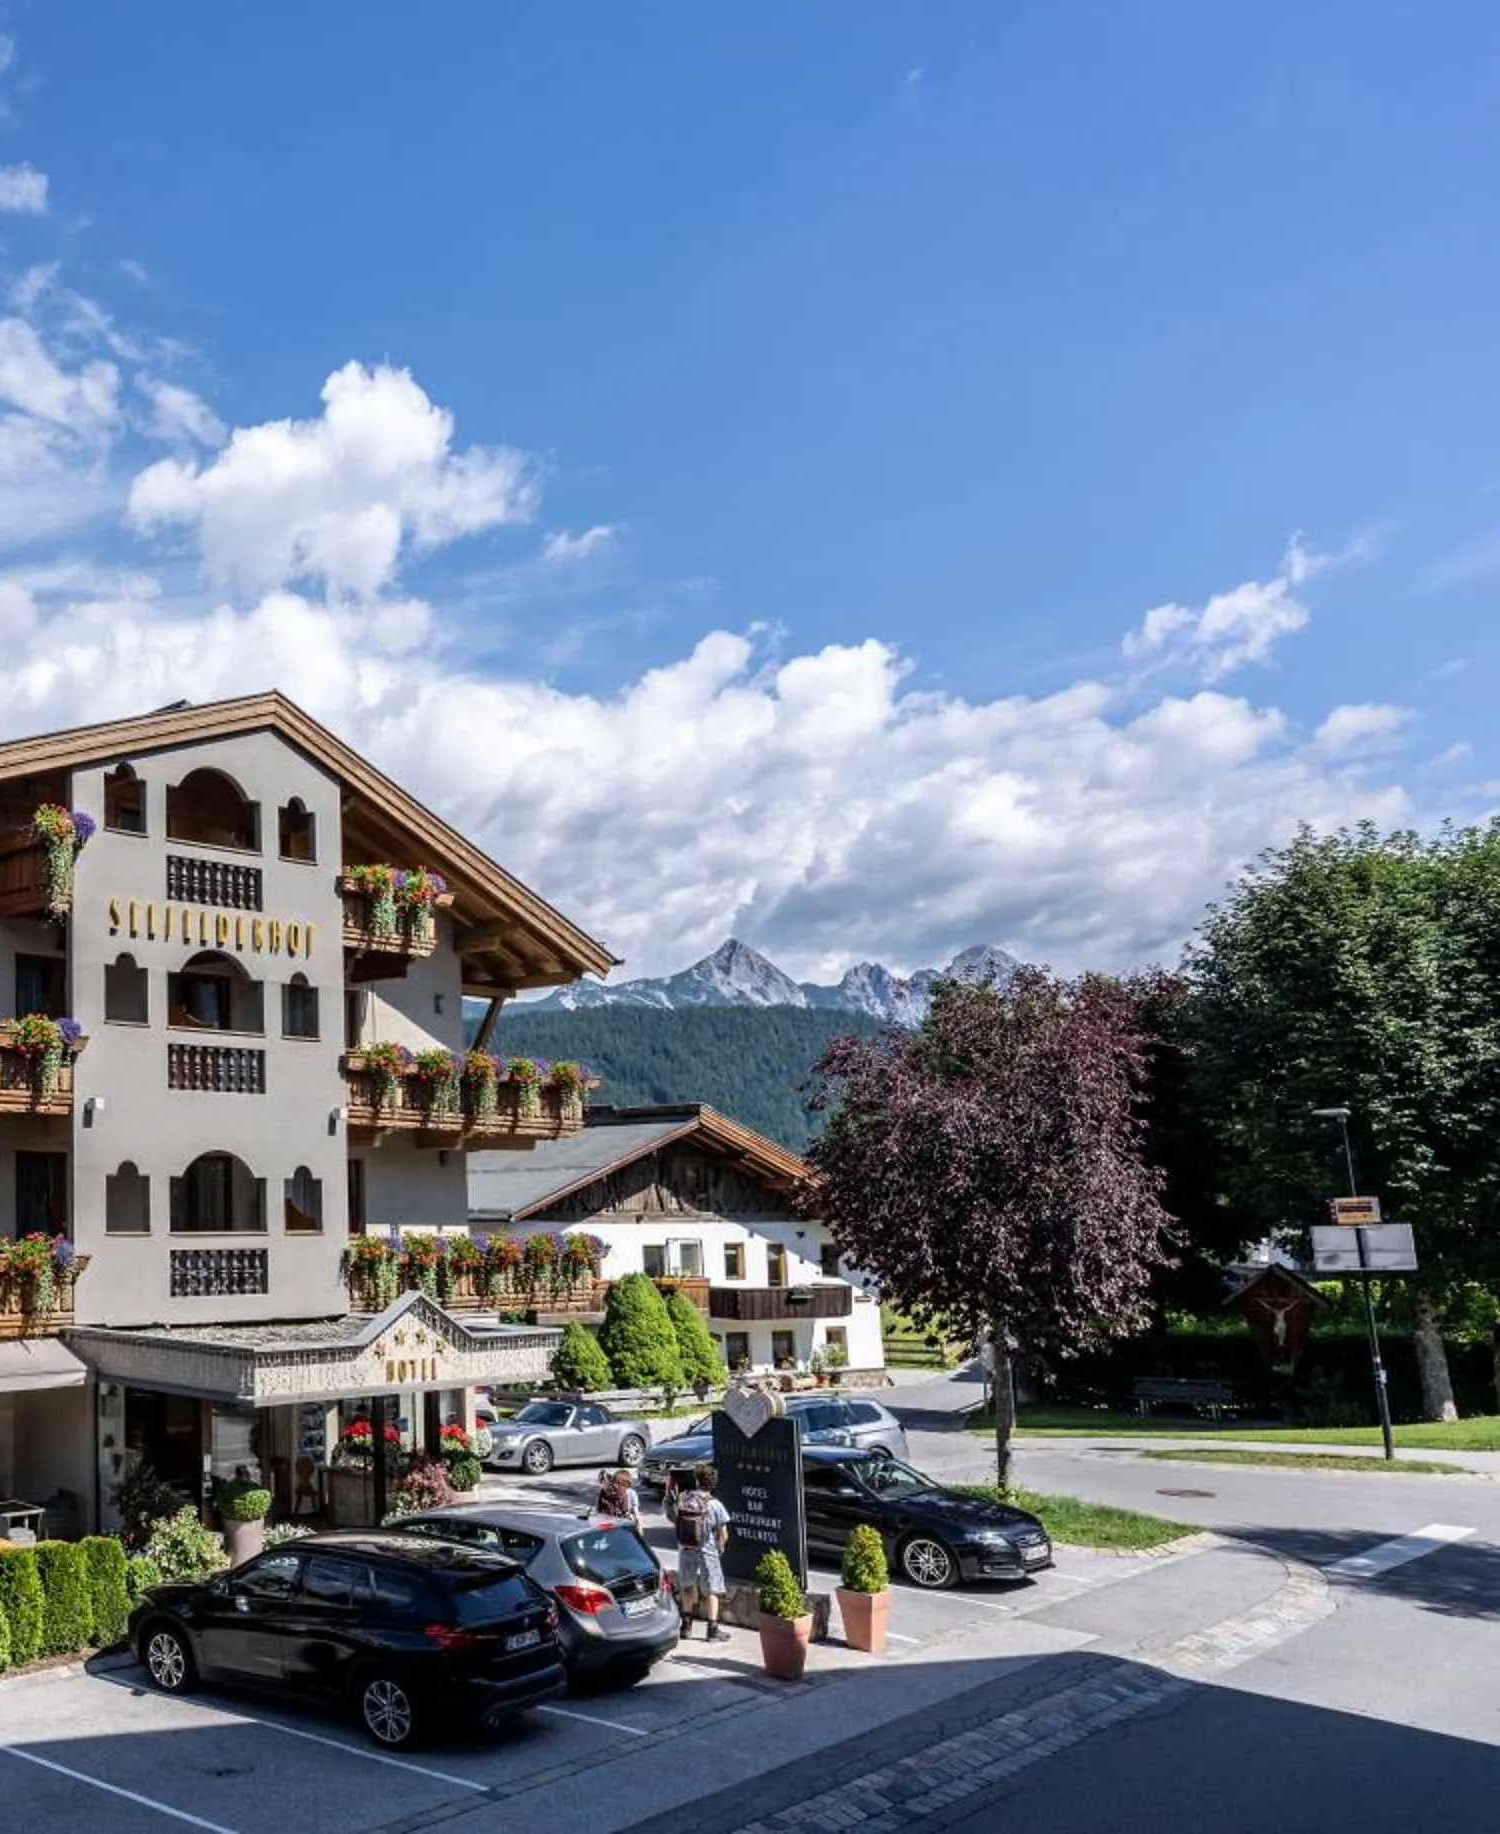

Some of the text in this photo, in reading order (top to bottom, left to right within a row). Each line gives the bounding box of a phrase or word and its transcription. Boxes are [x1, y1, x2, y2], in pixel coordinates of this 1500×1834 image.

[386, 1357, 436, 1383] HOTEL
[741, 1485, 768, 1499] HOTEL
[747, 1499, 763, 1511] BAR
[730, 1511, 782, 1529] RESTAURANT
[736, 1527, 778, 1543] WELLNESS
